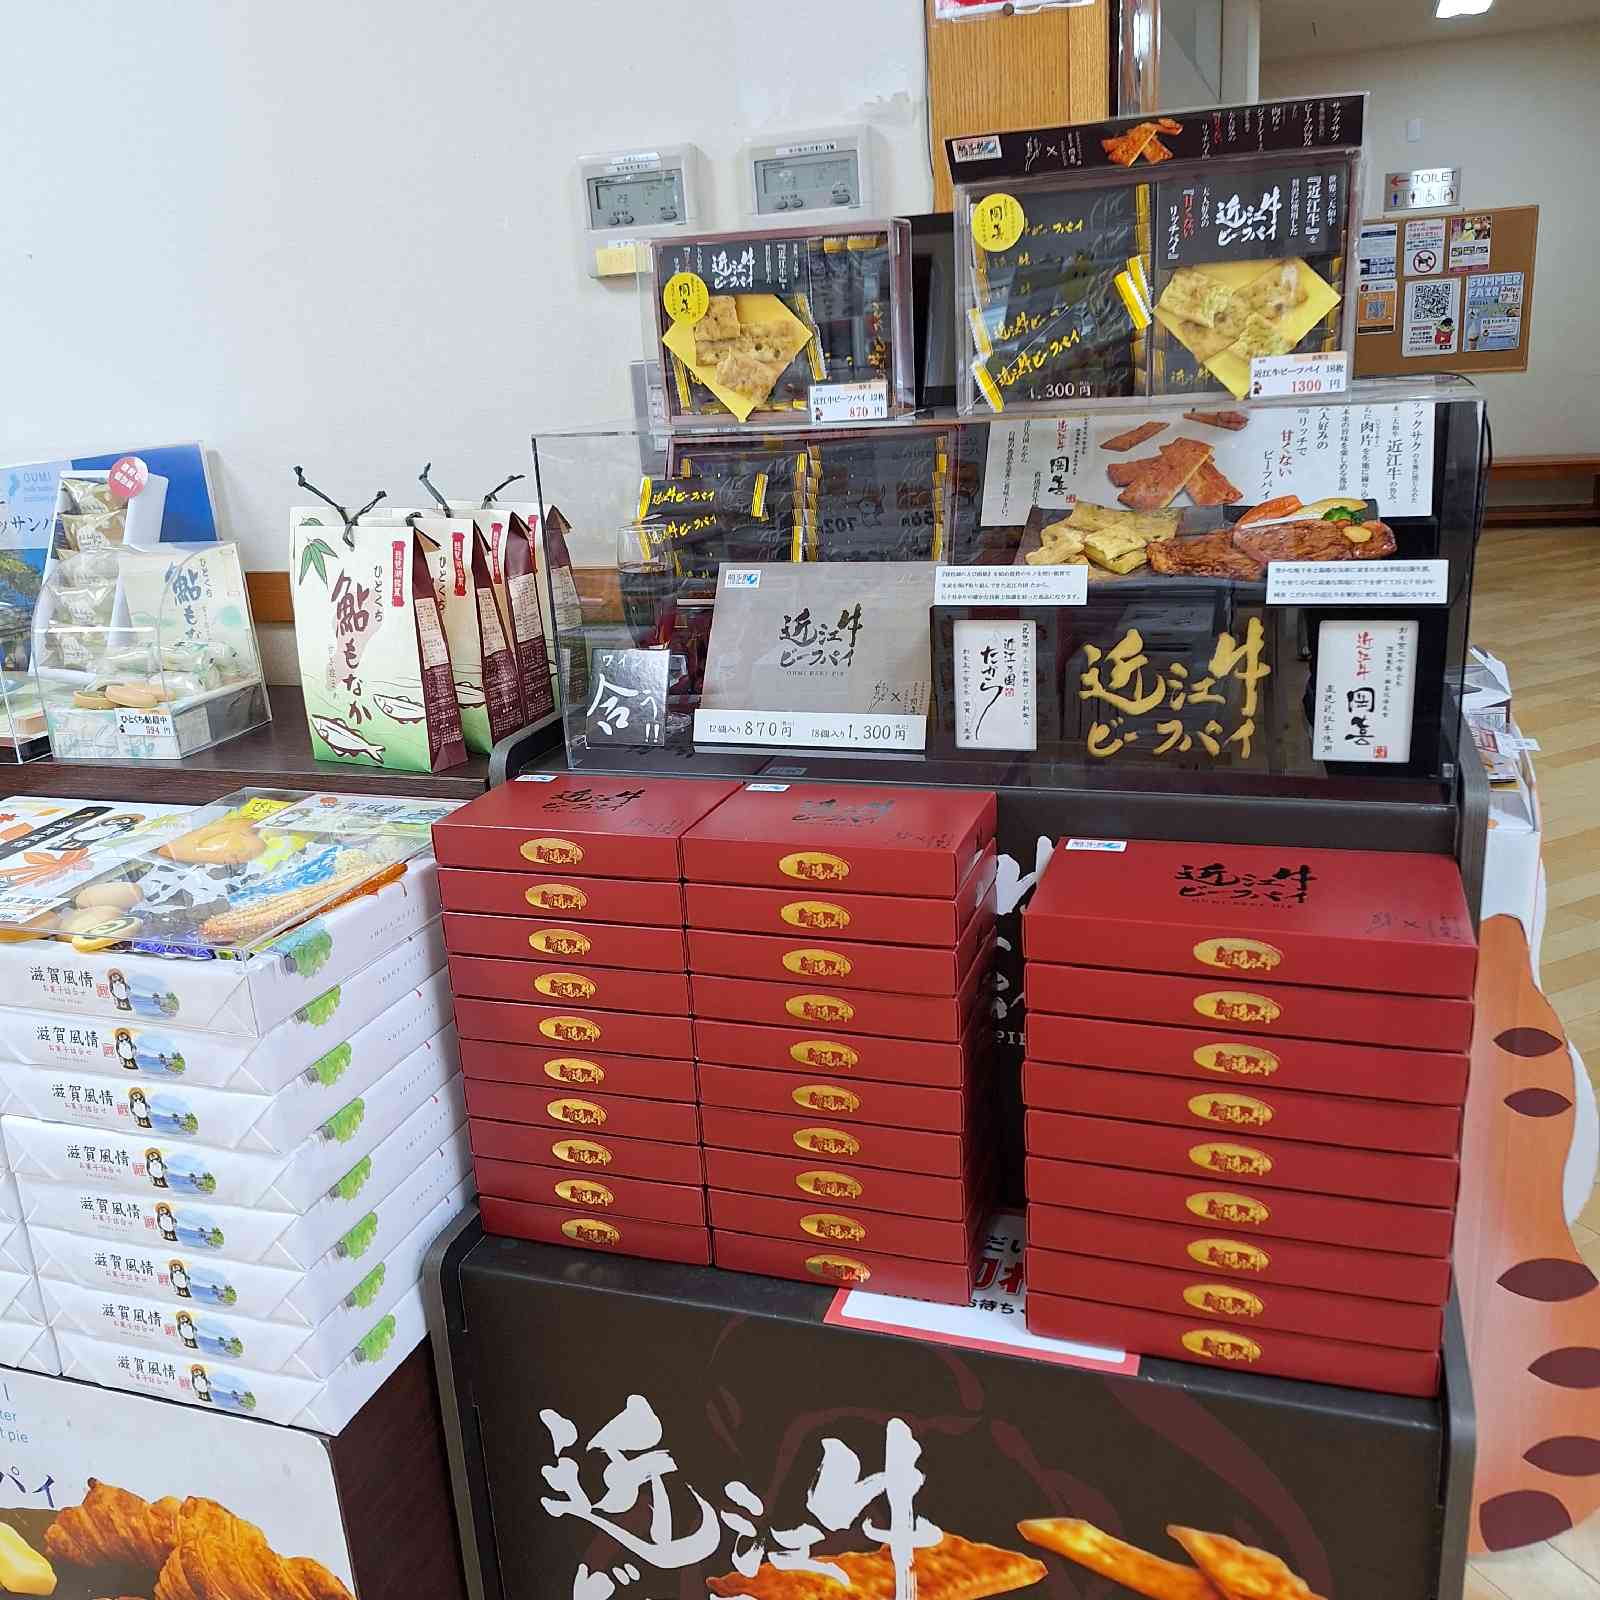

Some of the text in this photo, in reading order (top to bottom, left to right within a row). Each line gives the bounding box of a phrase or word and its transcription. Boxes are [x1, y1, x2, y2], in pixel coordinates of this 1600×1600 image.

[1415, 170, 1457, 185] TOILET
[1215, 185, 1282, 228] 近江牛
[1470, 275, 1521, 288] SUMMER
[1292, 380, 1322, 392] 1300
[850, 406, 869, 417] 870
[1279, 429, 1294, 478] 甘くない
[374, 565, 384, 623] ひとくち
[779, 602, 864, 648] 近江牛
[331, 568, 373, 725] 鮎もなか
[779, 648, 855, 668] ビーフパイ
[1079, 617, 1271, 718] 近江牛
[1087, 717, 1256, 760] ビーフパイ
[1174, 863, 1318, 888] 近江牛
[1179, 885, 1308, 903] ビーフパイ
[30, 967, 93, 988] 滋賀風情
[37, 1026, 99, 1049] 滋賀風情
[51, 1083, 114, 1107] 滋賀風情
[66, 1144, 130, 1167] 滋賀風情
[79, 1196, 141, 1220] 滋賀風情
[94, 1252, 155, 1277] 滋賀風情
[102, 1303, 163, 1327] 滋賀風情
[118, 1355, 177, 1381] 滋賀風情
[8, 1431, 29, 1443] pie
[540, 1394, 944, 1600] 近江牛
